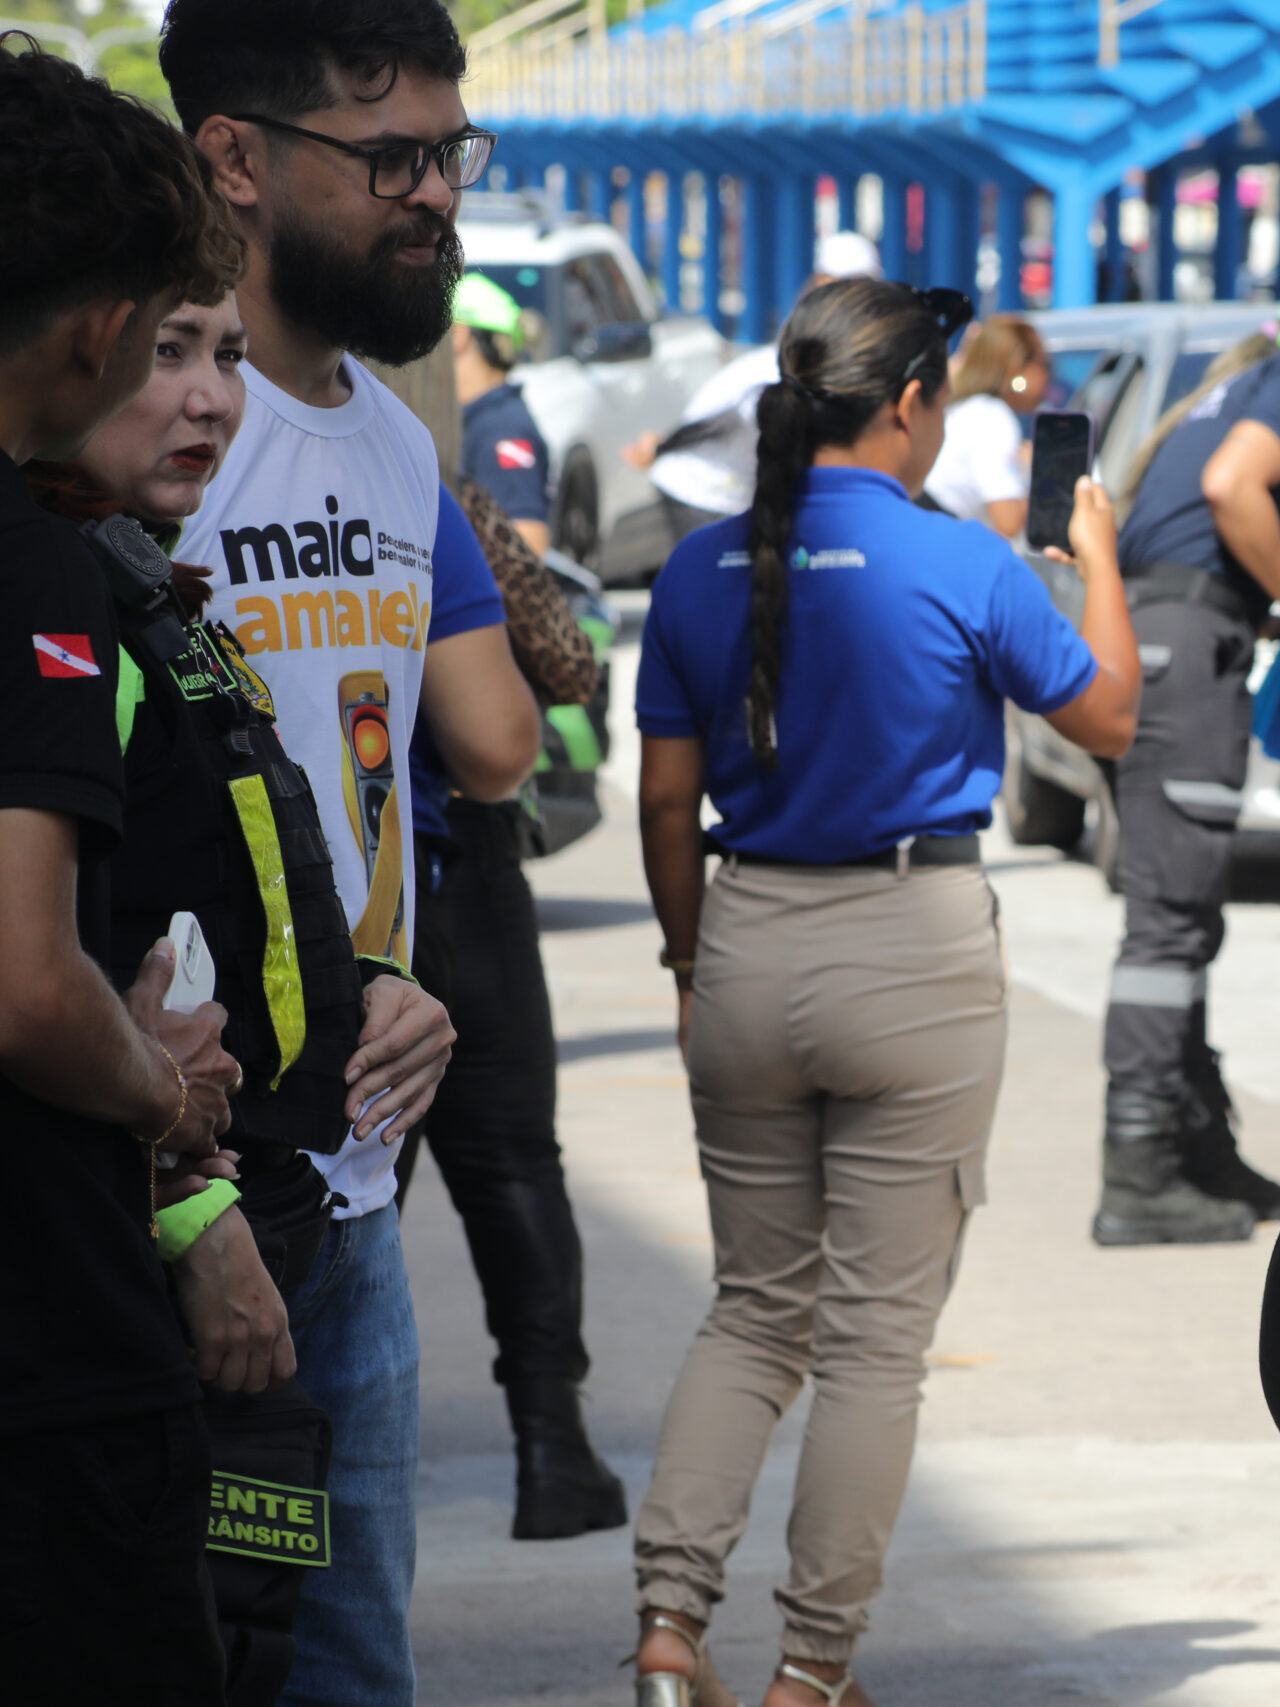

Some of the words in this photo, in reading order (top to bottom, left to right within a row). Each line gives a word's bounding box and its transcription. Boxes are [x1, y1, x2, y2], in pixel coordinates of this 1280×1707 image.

[219, 494, 375, 586] maio
[210, 1481, 315, 1525] ENTE
[208, 1513, 319, 1553] RÂNSITO
